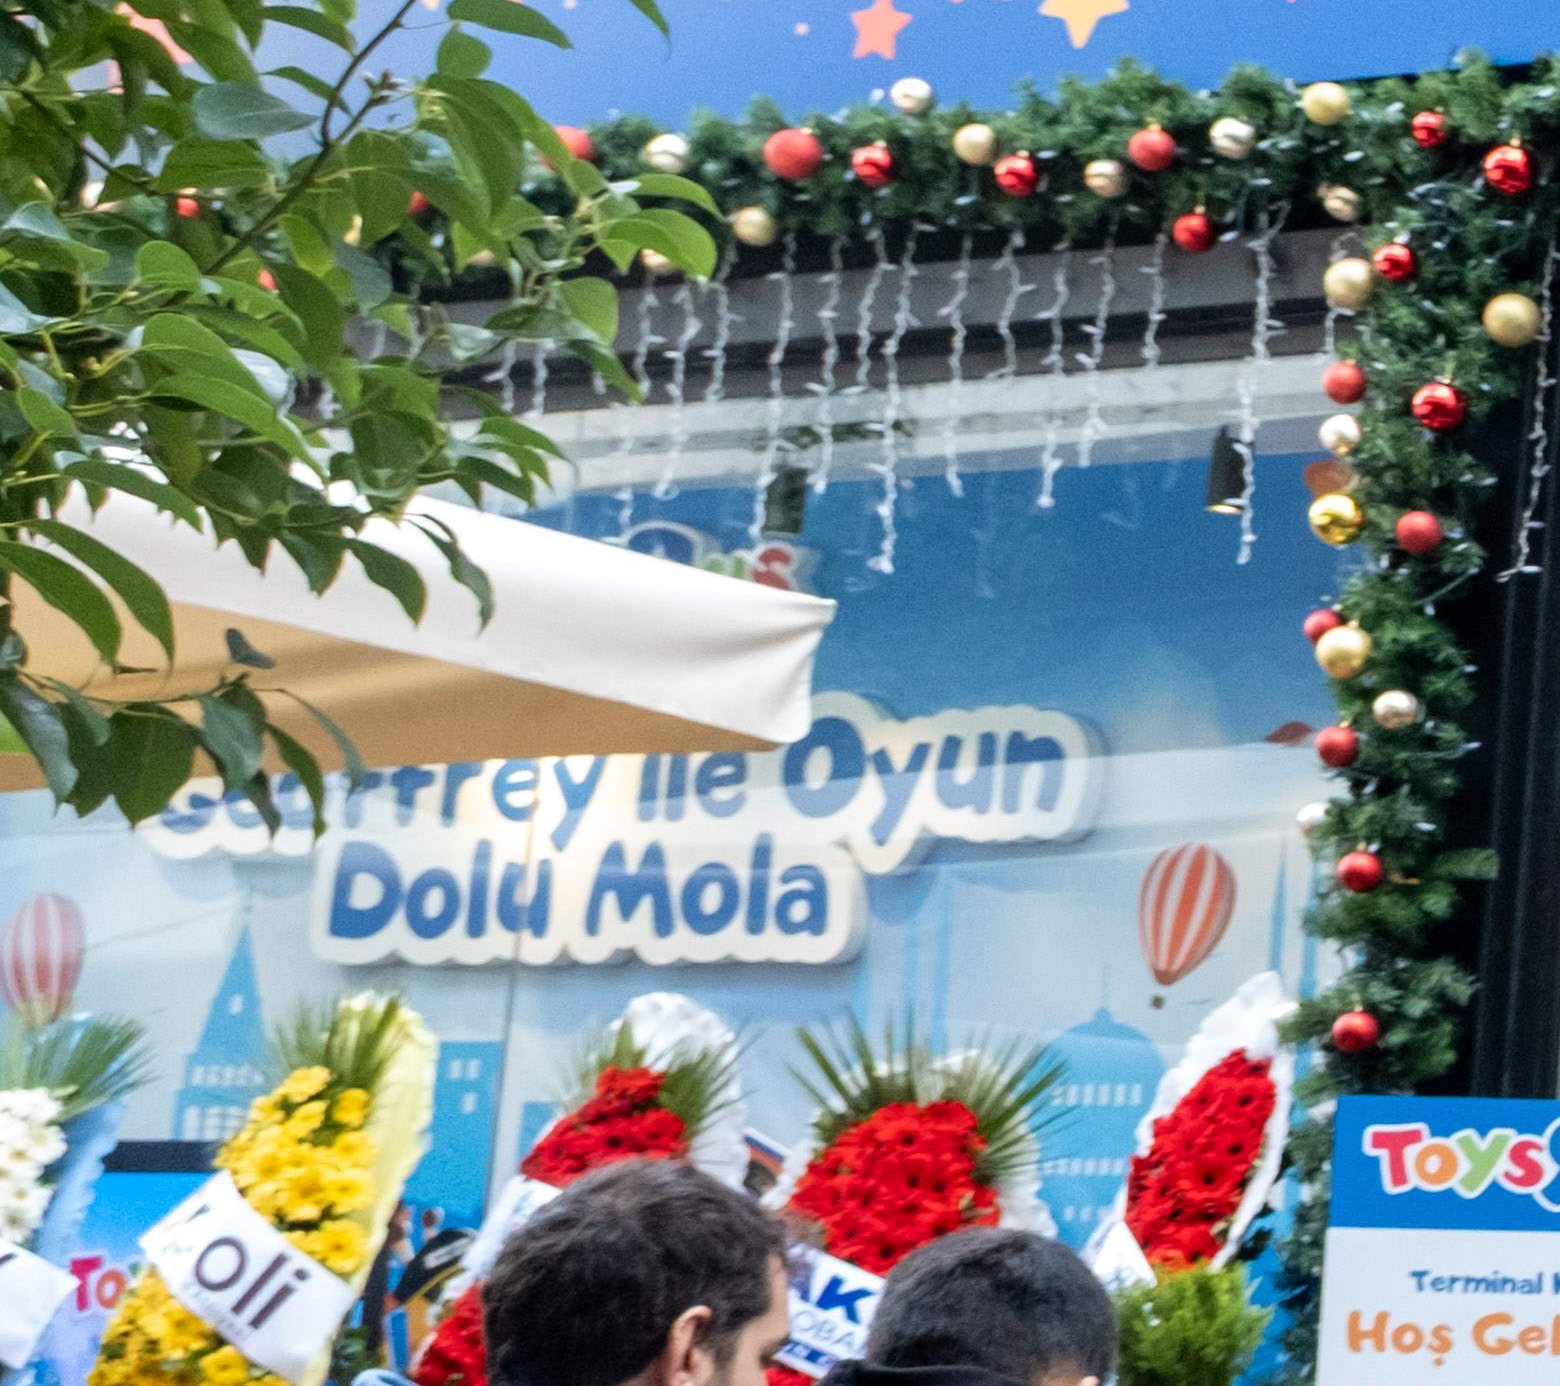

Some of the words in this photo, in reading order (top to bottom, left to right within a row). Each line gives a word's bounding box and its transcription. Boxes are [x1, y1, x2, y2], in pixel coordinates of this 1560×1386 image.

[784, 715, 1066, 846] Oyun
[329, 836, 550, 940] Dolu
[586, 832, 829, 939] Mola
[1410, 1269, 1544, 1297] Terminal
[1346, 1309, 1455, 1367] Hoş
